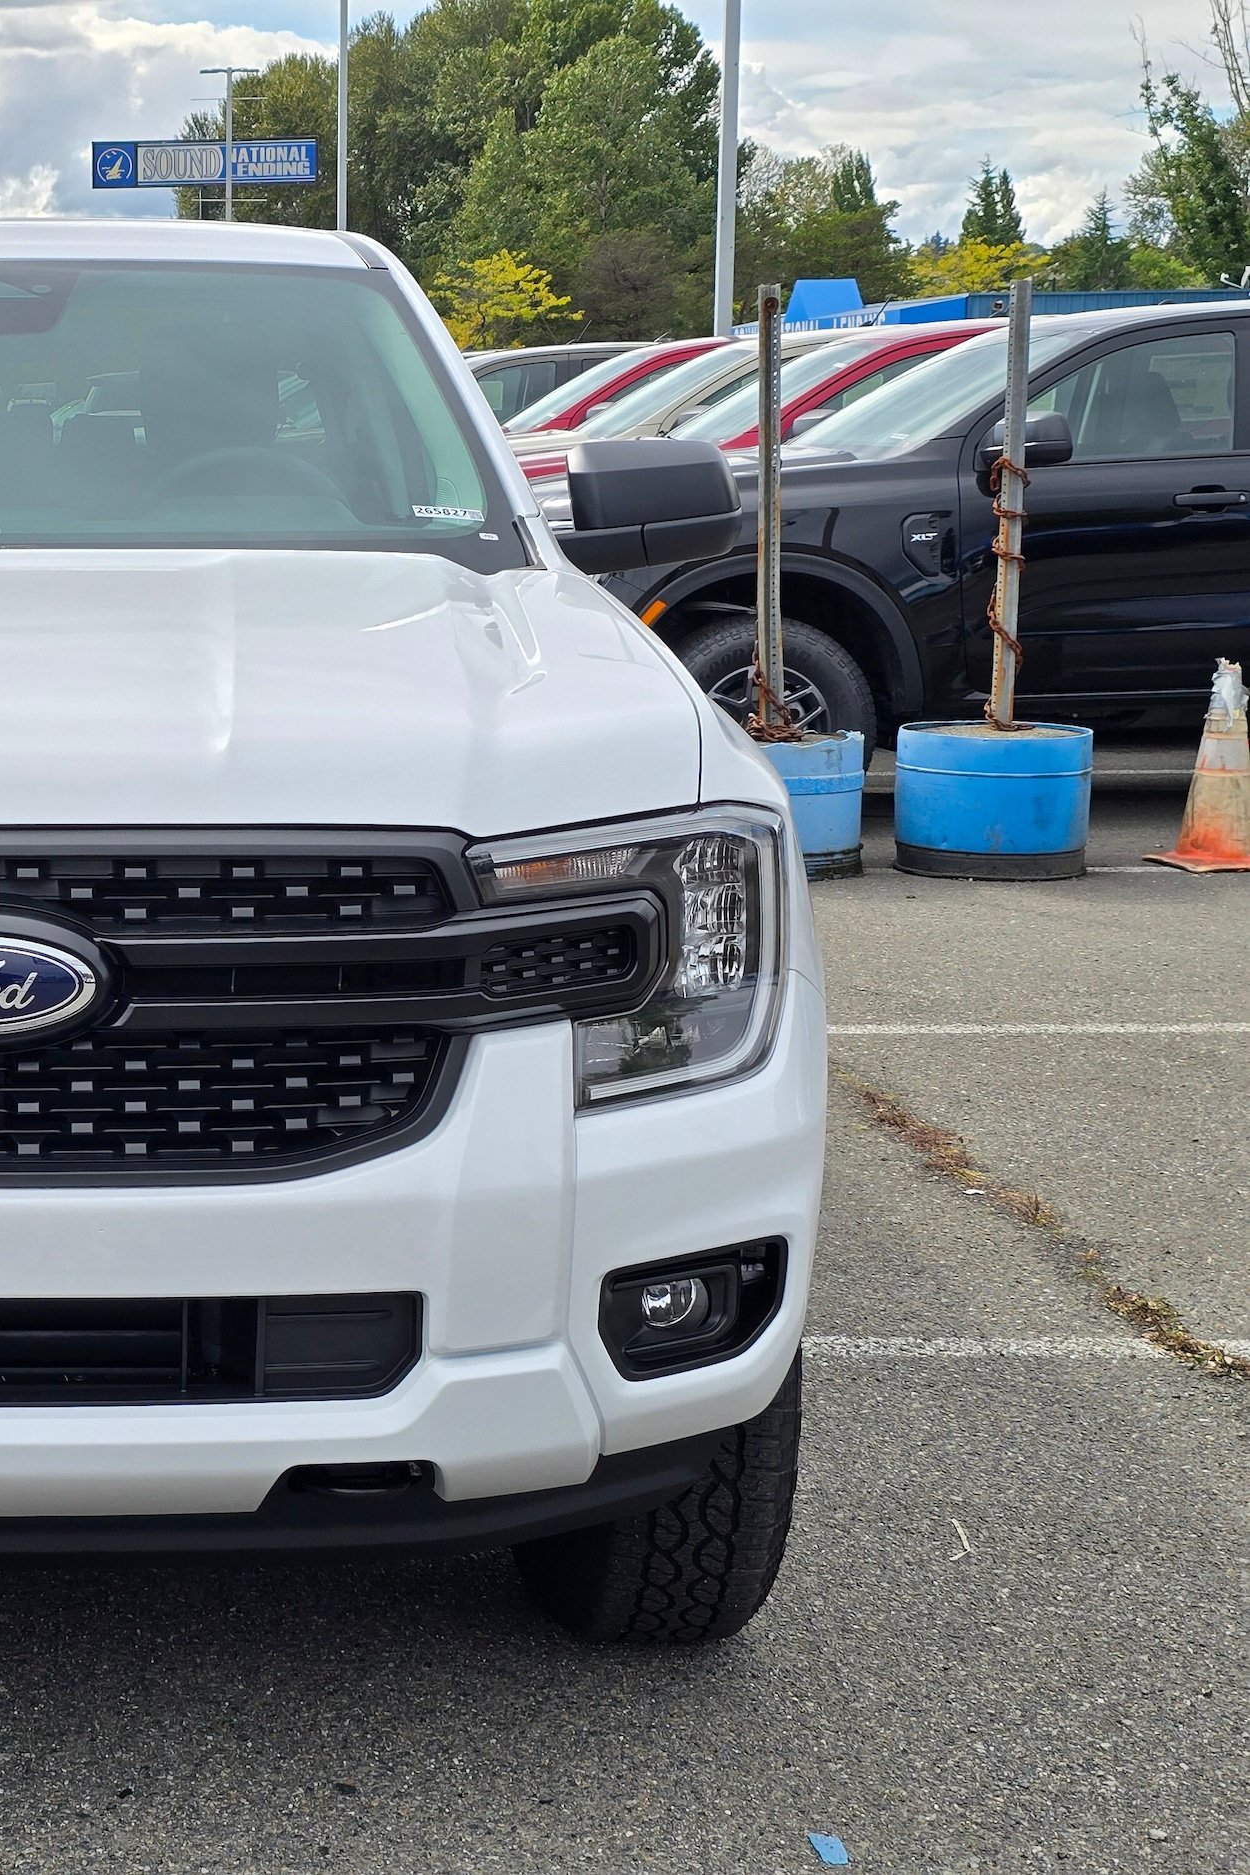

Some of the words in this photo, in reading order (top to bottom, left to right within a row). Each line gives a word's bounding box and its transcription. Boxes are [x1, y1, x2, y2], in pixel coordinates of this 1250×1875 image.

[143, 148, 221, 180] SOUND
[231, 162, 310, 176] ENDING
[910, 532, 938, 542] XLT
